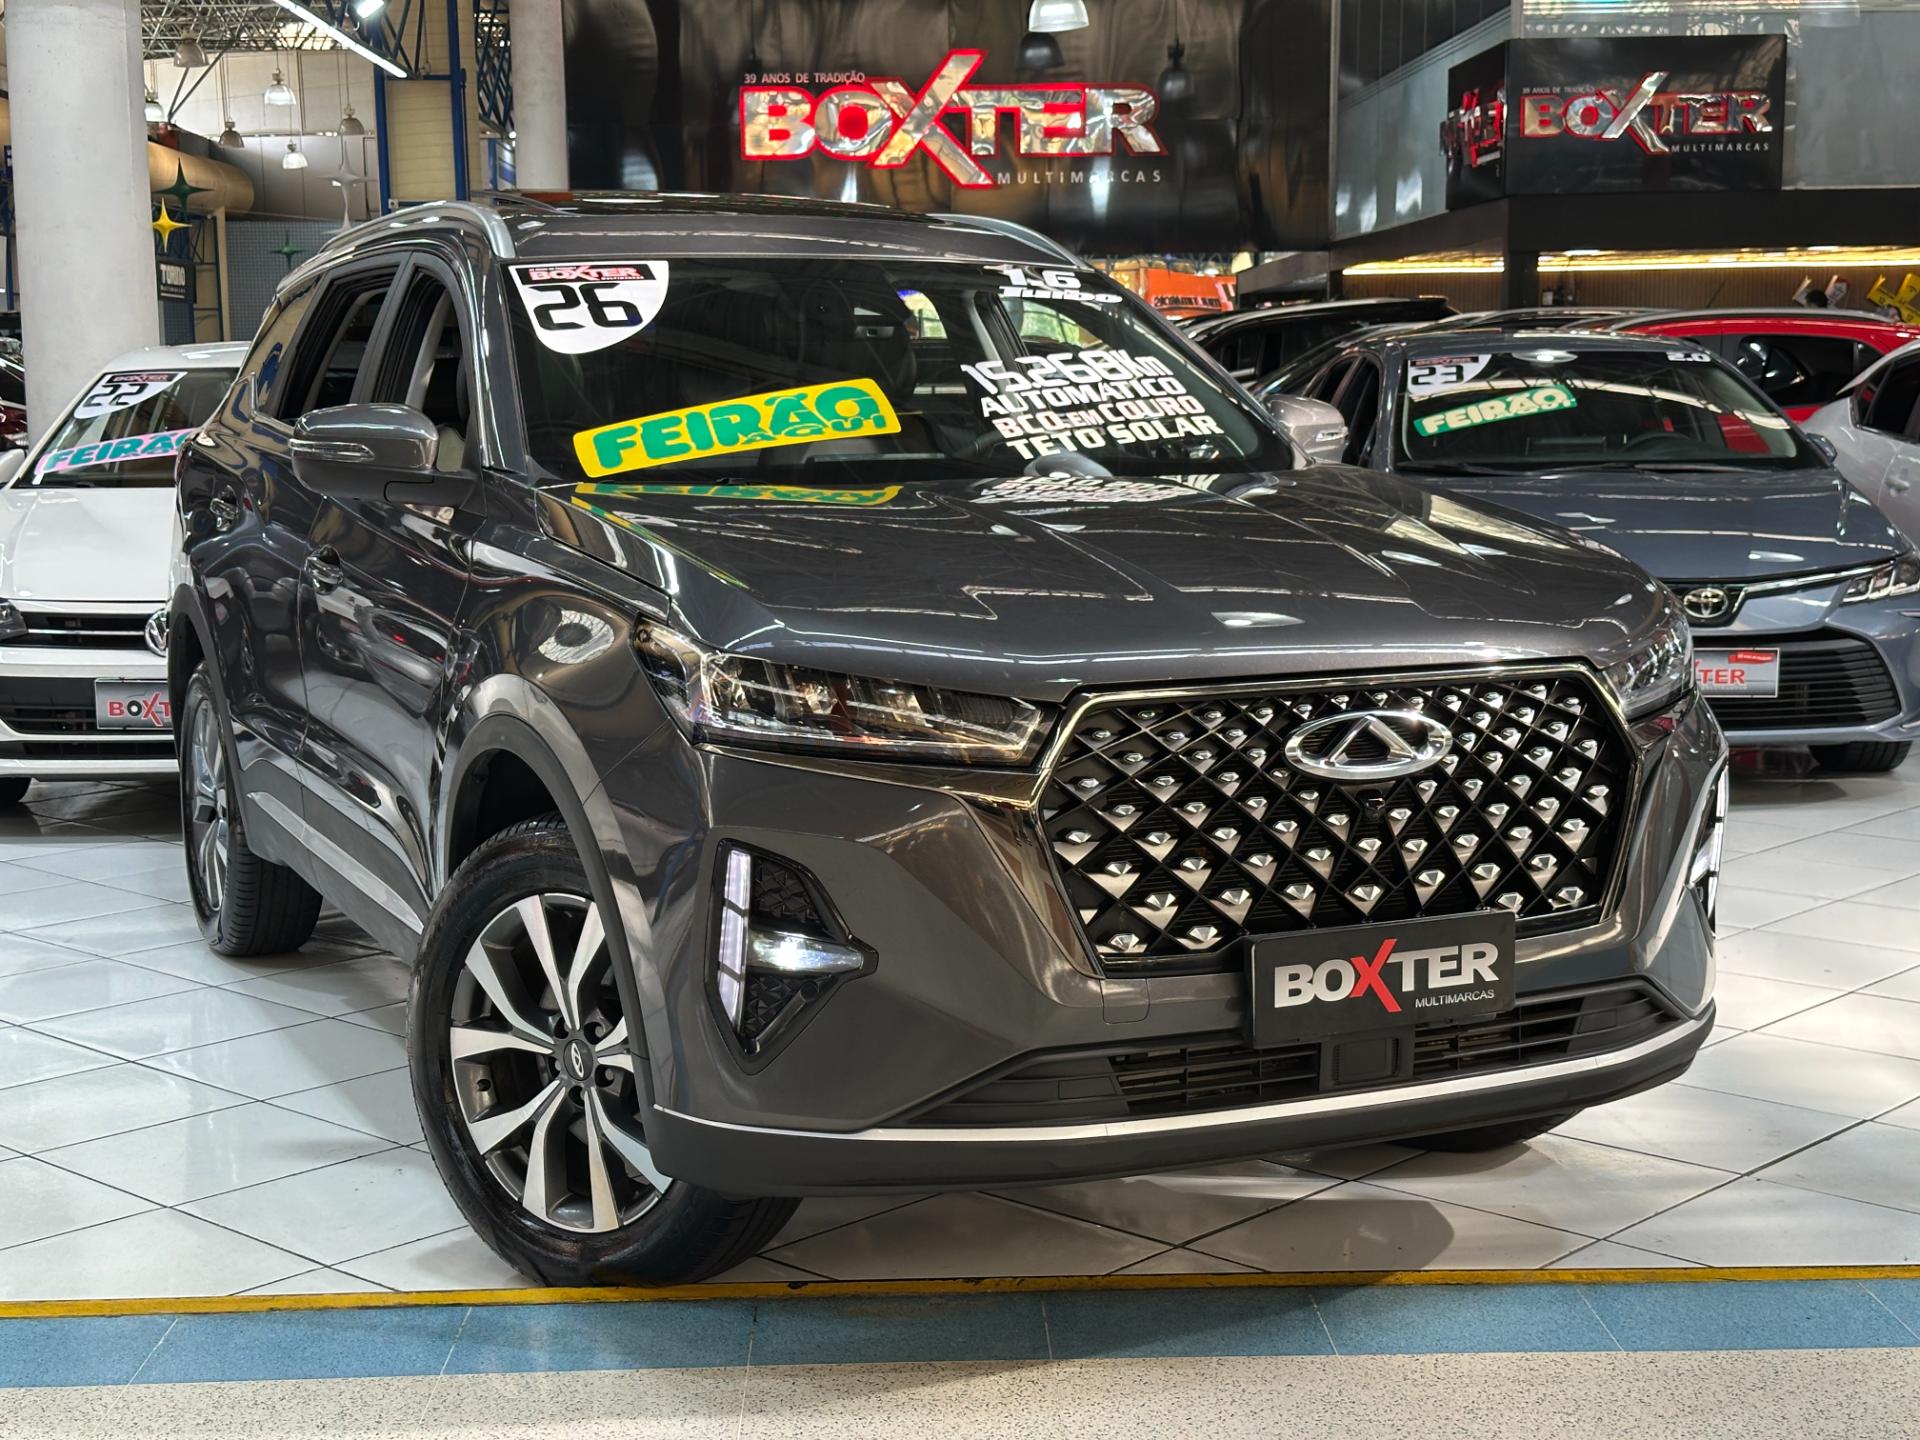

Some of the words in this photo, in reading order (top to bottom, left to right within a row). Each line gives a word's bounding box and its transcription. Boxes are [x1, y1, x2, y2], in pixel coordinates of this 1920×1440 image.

[744, 73, 757, 84] 39
[762, 73, 791, 83] ANOS
[795, 73, 809, 83] DE
[814, 70, 866, 85] TRADIÇÃO
[739, 48, 1168, 190] BOXTER
[1520, 71, 1774, 155] BOXTER
[1670, 141, 1770, 153] MULTIMARCAS
[529, 264, 642, 282] BOXTER
[1003, 267, 1082, 290] 1.6
[529, 282, 644, 332] 26
[1411, 365, 1465, 386] 23
[82, 383, 150, 408] 22
[980, 377, 1187, 418] AUTOMATICO
[1066, 409, 1105, 427] EM
[1099, 395, 1206, 422] COURO
[1422, 387, 1568, 434] FEIRÃO
[592, 386, 881, 469] FEIRÃO
[1006, 427, 1106, 461] TETO
[1106, 415, 1225, 445] SOLAR
[1695, 658, 1746, 685] TER
[1274, 937, 1500, 1013] BOXTER
[1415, 989, 1495, 1009] MULTIMARCAS
